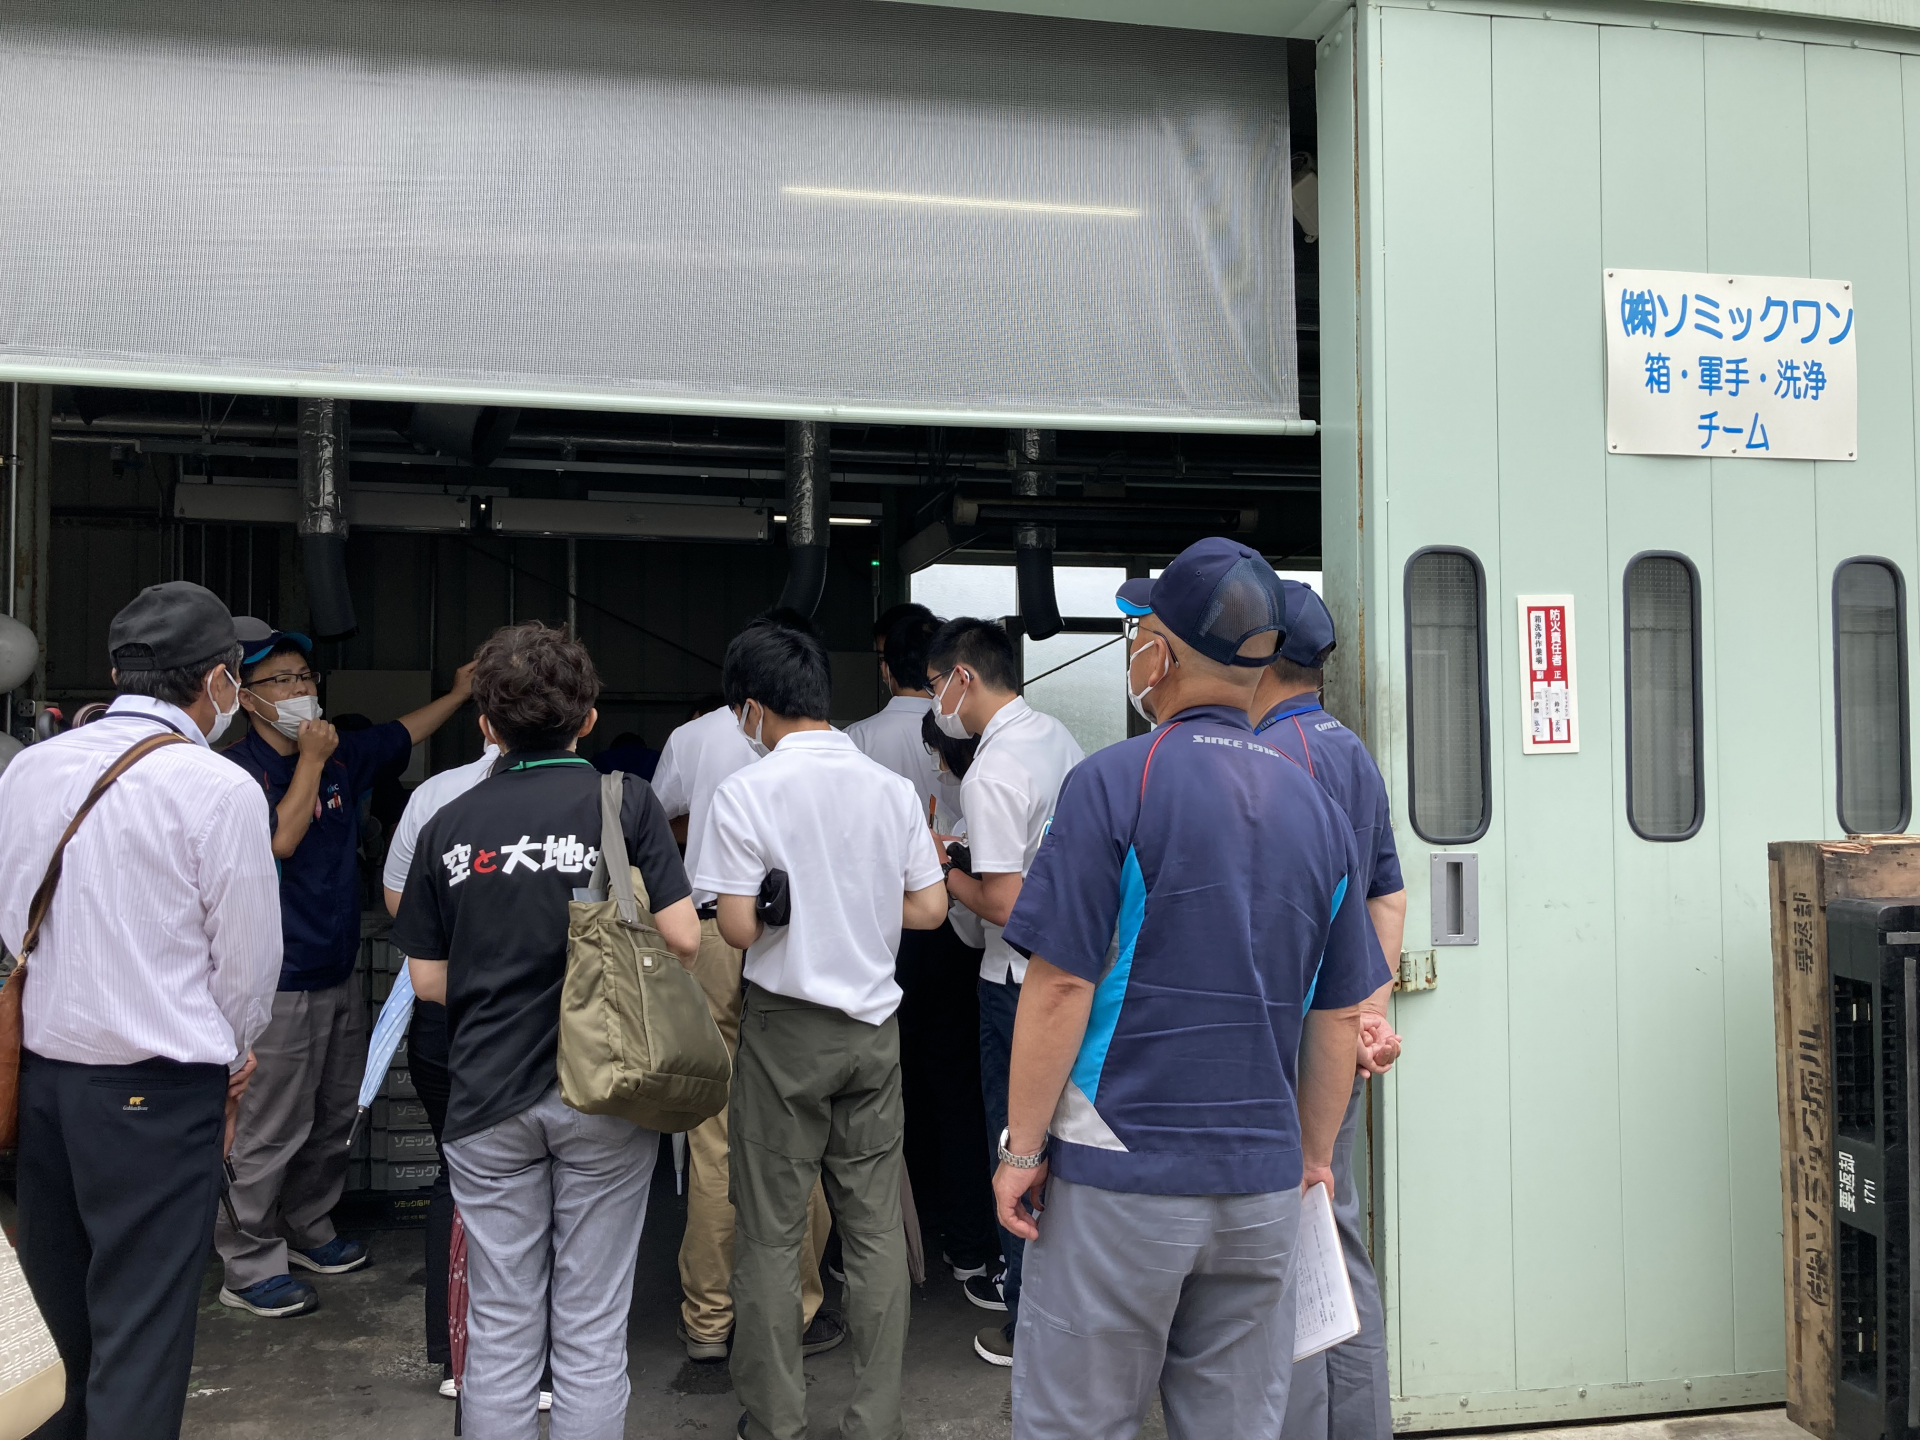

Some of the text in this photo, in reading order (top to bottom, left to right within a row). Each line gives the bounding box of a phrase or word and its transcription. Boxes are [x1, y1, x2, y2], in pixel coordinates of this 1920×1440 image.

[1645, 352, 1827, 401] 箱・軍手・洗浄
[1698, 411, 1770, 451] チーム
[1549, 609, 1562, 666] 防火責任者
[1192, 734, 1243, 749] SINCE
[442, 834, 601, 887] 空と大地と
[395, 1135, 437, 1147] ソミック
[1838, 1151, 1856, 1212] 要返却
[1863, 1178, 1876, 1205] 1711
